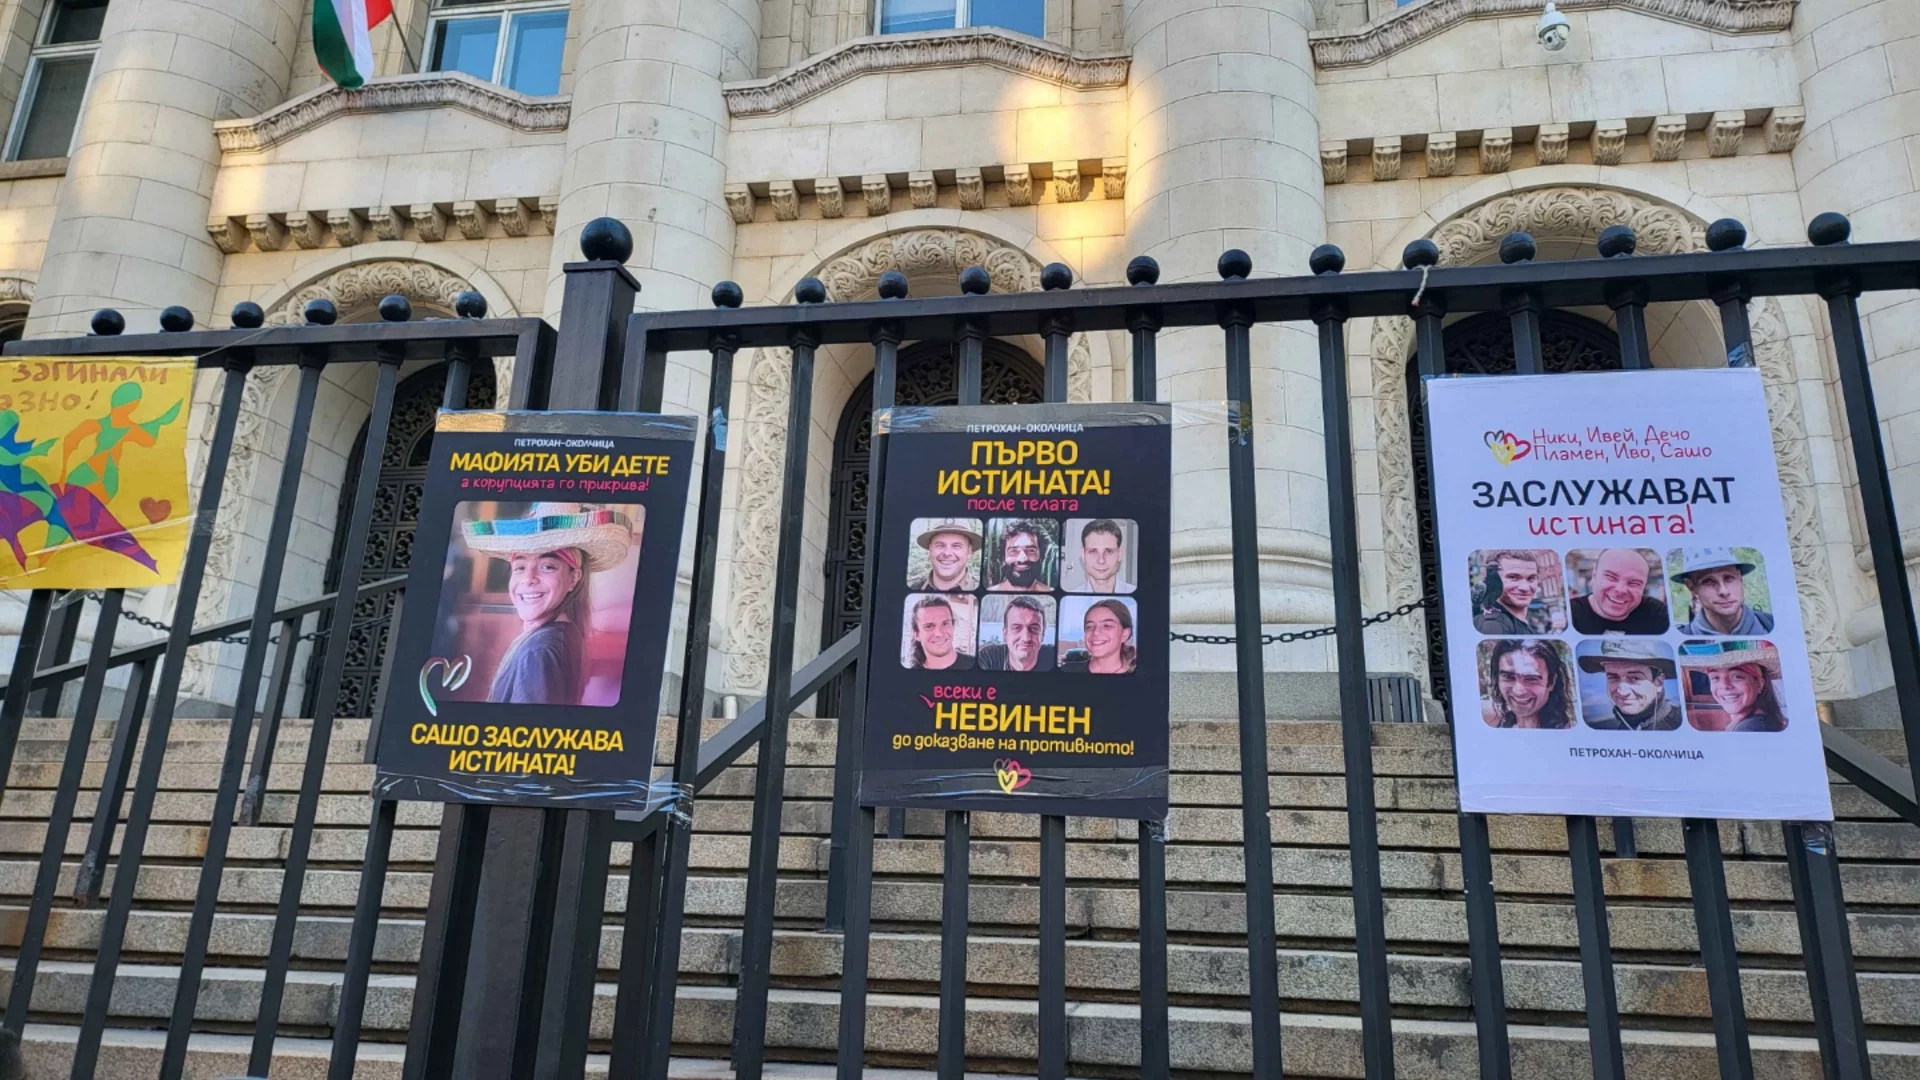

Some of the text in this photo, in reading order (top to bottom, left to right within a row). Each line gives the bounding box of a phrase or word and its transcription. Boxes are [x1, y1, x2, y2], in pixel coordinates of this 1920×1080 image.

[966, 422, 1084, 434] ПЕТРОХАН-ОКОЛЧИЦА
[1532, 425, 1691, 446] Ники, Ивей, Дечо
[513, 437, 615, 449] ПЕТРОХАН-ОКОЛЧИЦА
[970, 440, 1079, 466] ПЪРВО
[1533, 442, 1713, 464] Пламен, Иво, Сашо
[450, 451, 671, 477] МАФИЯТА УБИ ДЕТЕ
[461, 476, 650, 494] а корупцията го прикрива!
[937, 469, 1111, 496] ИСТИНАТА!
[1471, 476, 1736, 508] ЗАСЛУЖАВАТ
[967, 498, 1079, 512] после телата
[1528, 503, 1696, 537] истината!
[933, 685, 998, 701] всеки е
[934, 702, 1092, 736] НЕВИНЕН
[410, 722, 624, 752] САШО ЗАСЛУЖАВА
[892, 733, 1135, 756] до доказване на противното!
[448, 750, 577, 776] ИСТИНАТА!
[1569, 747, 1705, 761] ПЕТРОХАН-ОКОЛЧИЦА
